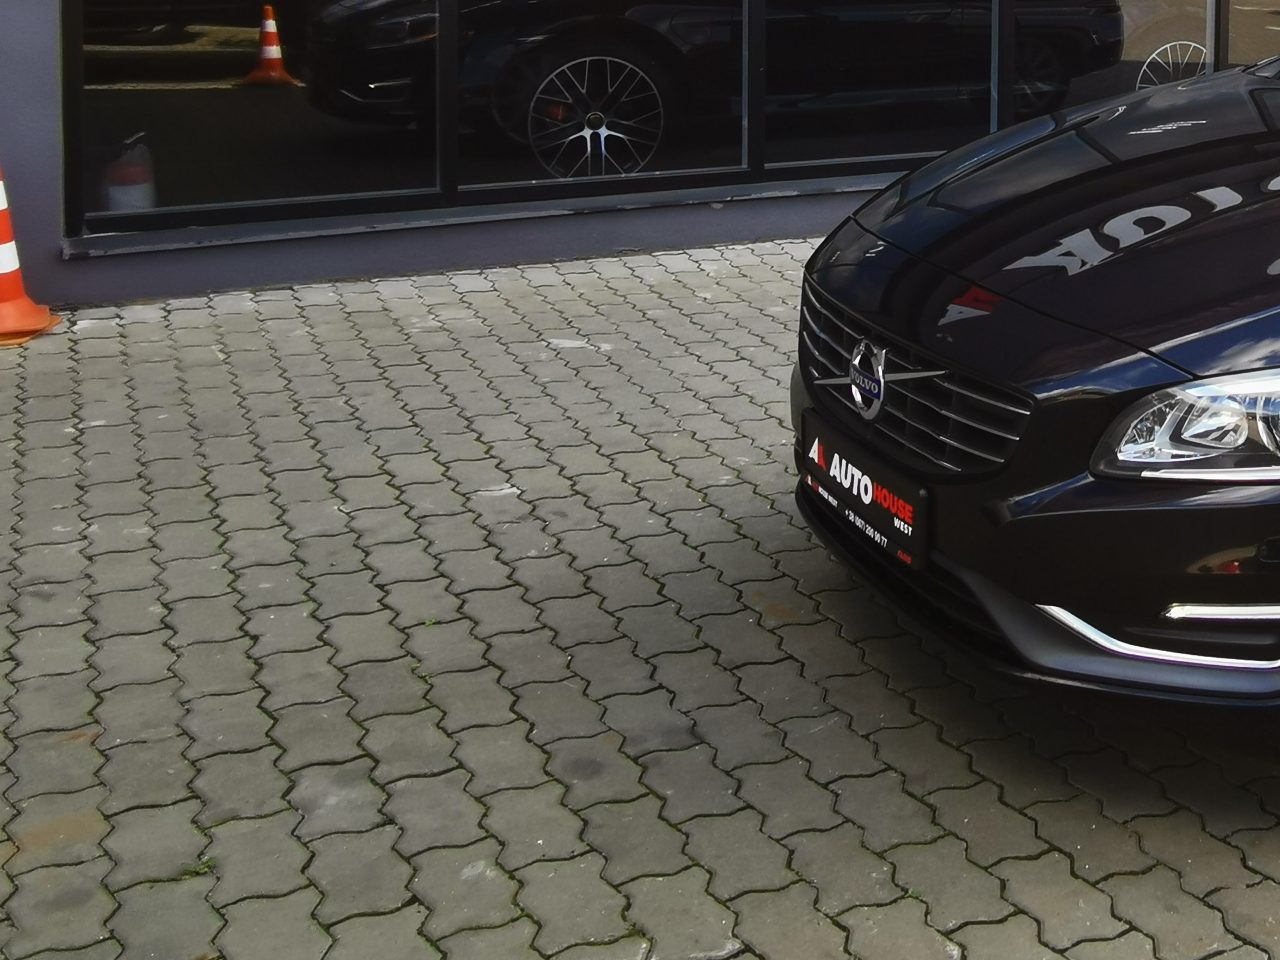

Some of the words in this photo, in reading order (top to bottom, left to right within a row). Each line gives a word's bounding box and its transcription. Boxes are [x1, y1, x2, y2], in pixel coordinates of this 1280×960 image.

[851, 368, 879, 394] VOLVO
[829, 453, 873, 505] AUTO
[873, 482, 913, 525] HOUSE
[893, 517, 913, 537] WEST
